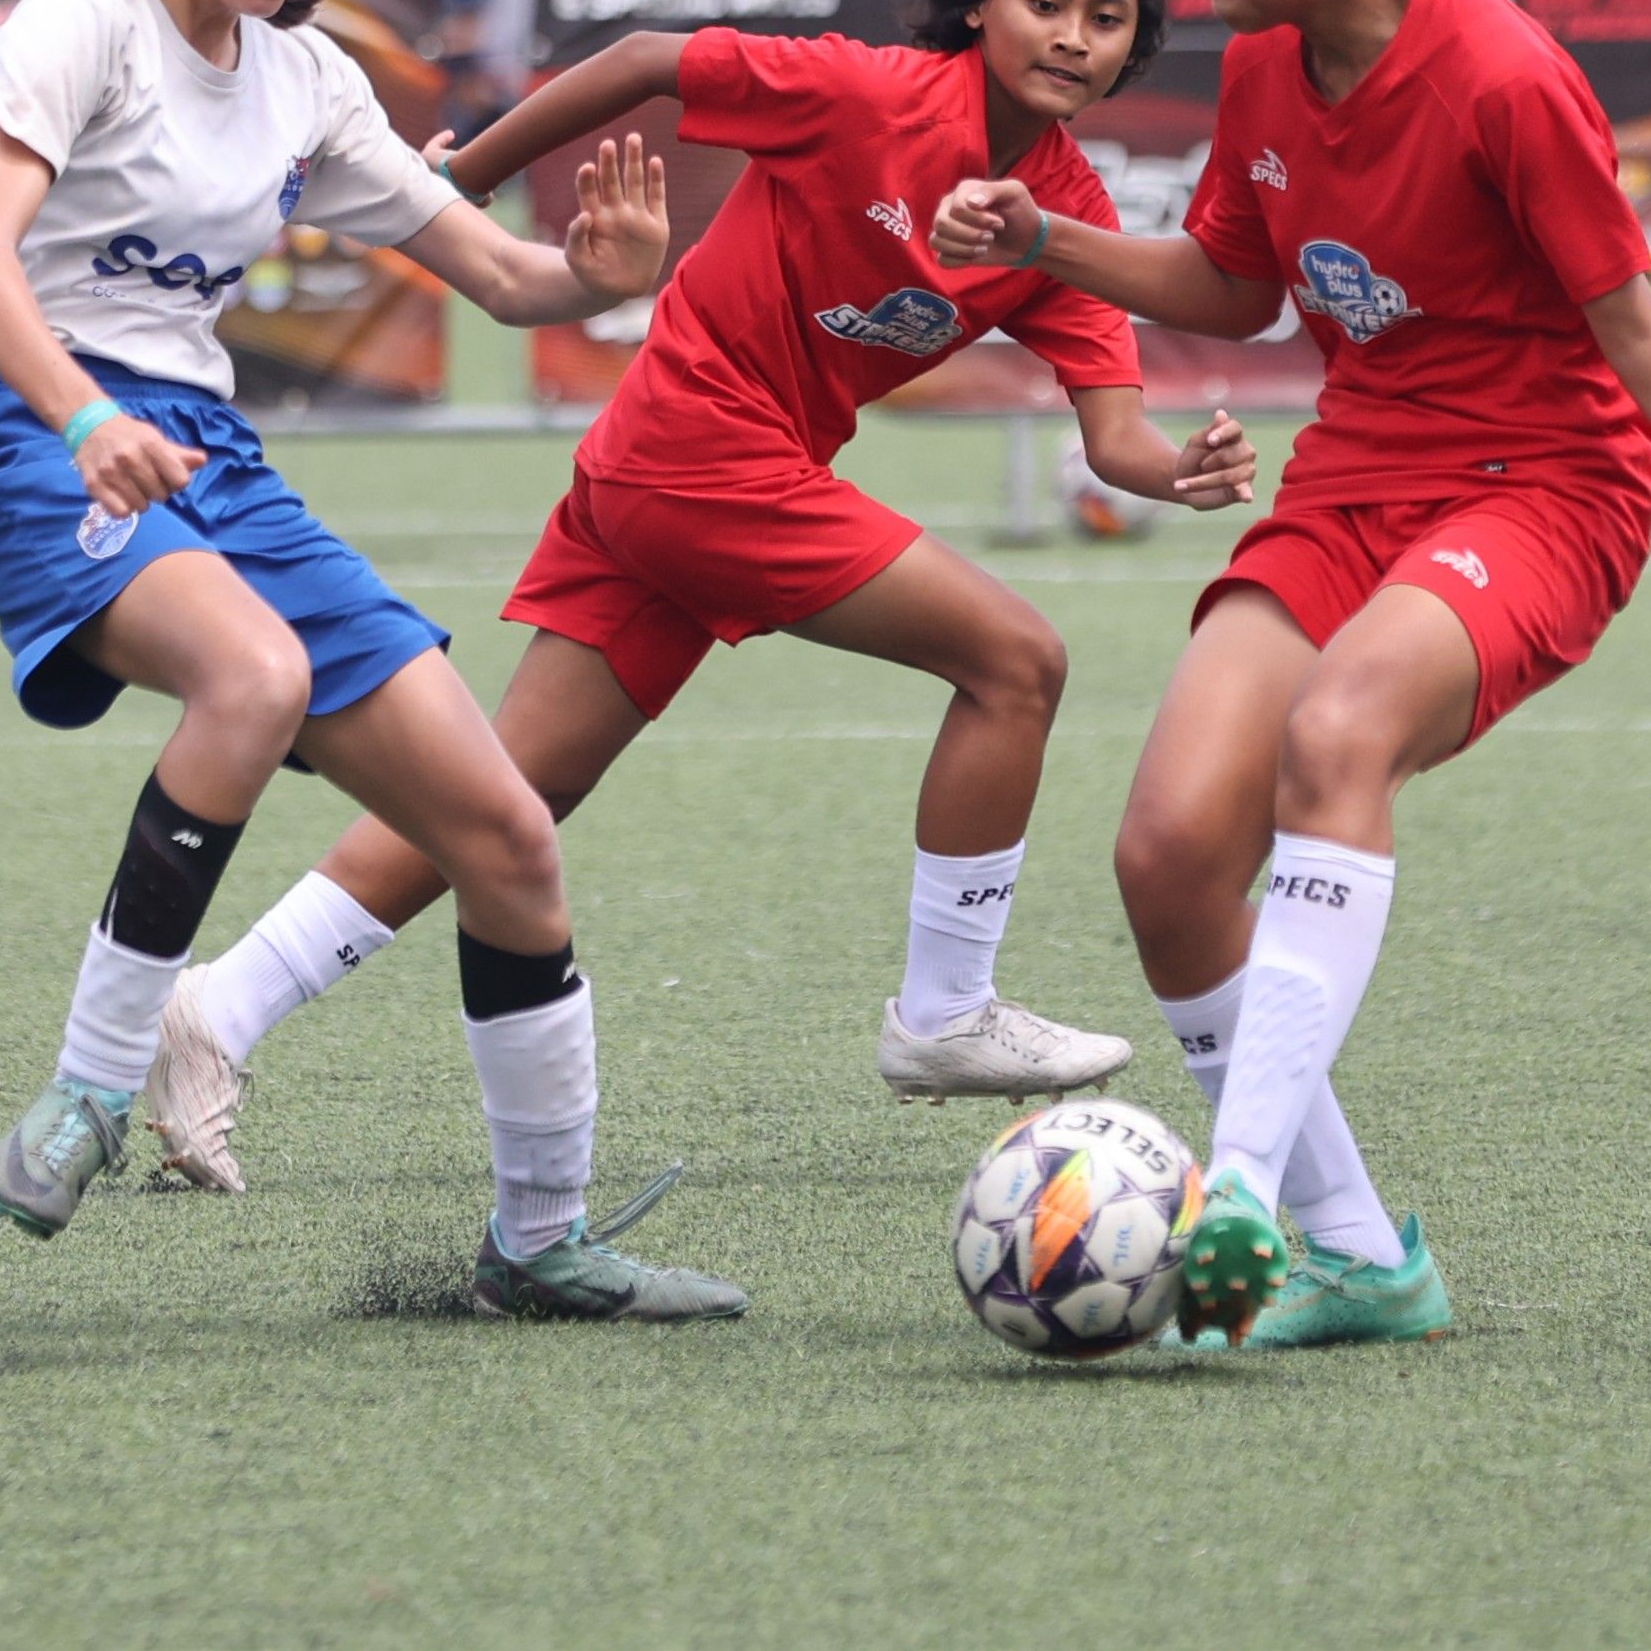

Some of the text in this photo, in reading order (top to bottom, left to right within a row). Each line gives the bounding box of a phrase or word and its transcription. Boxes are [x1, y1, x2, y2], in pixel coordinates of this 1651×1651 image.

[1250, 164, 1288, 191] SPECS
[865, 204, 913, 241] SPECS
[1312, 255, 1359, 281] hydro
[1327, 278, 1363, 299] plus
[1042, 1111, 1174, 1175] SELECT
